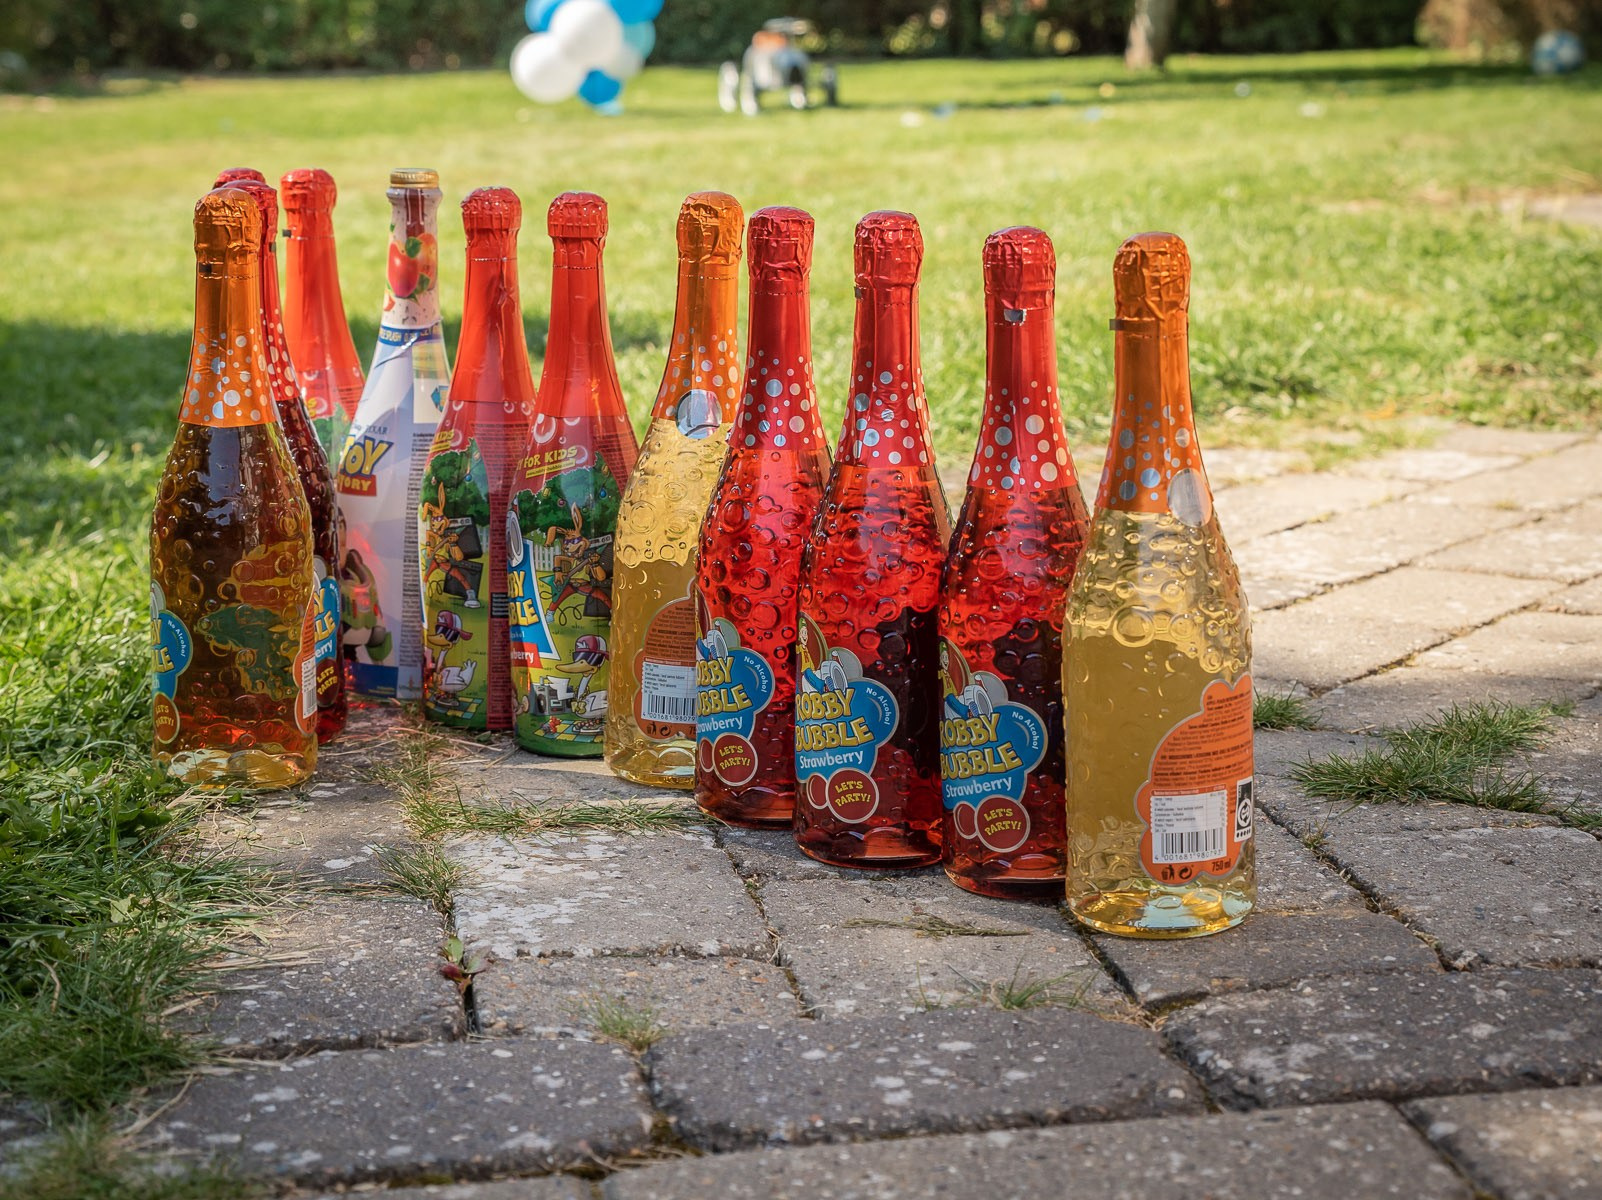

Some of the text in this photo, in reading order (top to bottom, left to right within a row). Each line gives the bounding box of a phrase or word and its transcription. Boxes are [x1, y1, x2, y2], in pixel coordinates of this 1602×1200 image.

[523, 454, 541, 468] FOR
[544, 445, 577, 463] KIDS
[338, 474, 371, 491] TORY
[696, 656, 734, 687] OBBY
[744, 656, 768, 693] No Alcohol
[696, 684, 753, 716] UBBLE
[796, 688, 855, 721] ROBBY
[865, 687, 891, 725] No Alcohol
[795, 717, 874, 752] BUBBLE
[939, 712, 1000, 748] ROBBY
[1011, 711, 1039, 750] No Alcohol
[719, 745, 744, 757] LET'S
[800, 750, 864, 769] Strawberry
[940, 742, 1023, 779] BUBBLE
[719, 756, 751, 770] PARTY!
[835, 780, 864, 793] LET'S
[945, 776, 1012, 798] Strawberry
[835, 793, 871, 807] PARTY!
[983, 808, 1013, 822] LET'S
[984, 821, 1022, 836] PARTY!
[1211, 860, 1224, 872] 750
